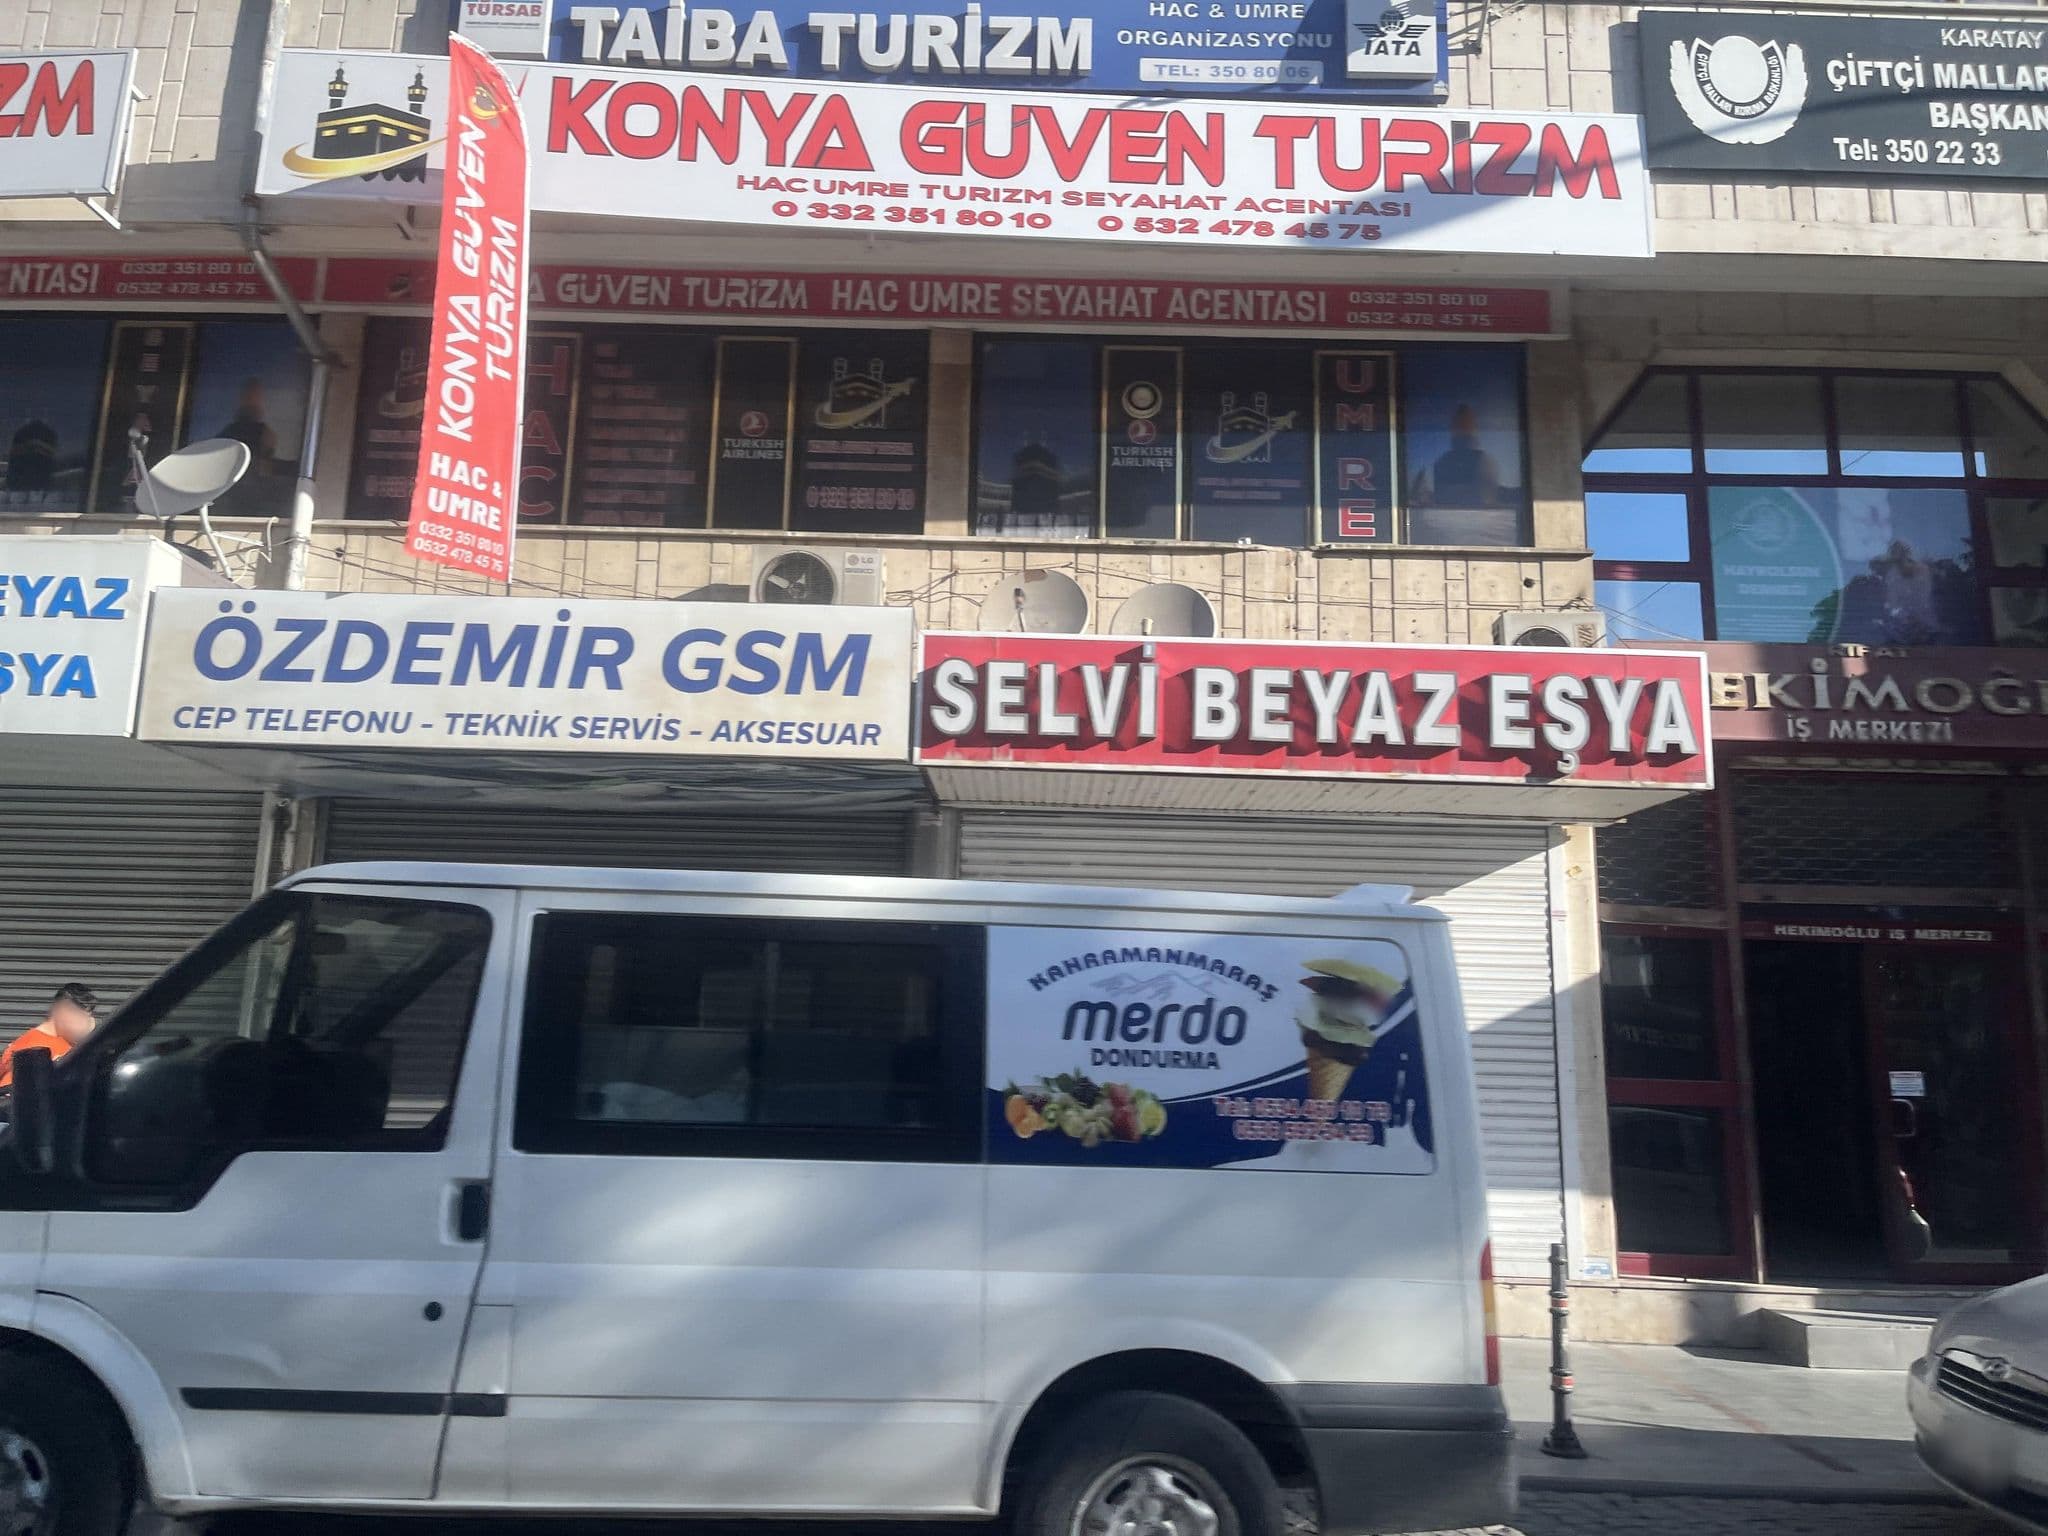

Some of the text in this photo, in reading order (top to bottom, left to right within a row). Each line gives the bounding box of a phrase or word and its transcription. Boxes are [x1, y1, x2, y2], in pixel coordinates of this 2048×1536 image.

[467, 0, 542, 17] TÜRSAB
[1149, 2, 1305, 20] HAC & UMRE
[570, 0, 1093, 74] TAİBA TURİZM
[1117, 28, 1332, 48] ORGANİZASYONU
[1364, 40, 1422, 57] IATA
[1941, 28, 2045, 49] KARATAY
[1154, 64, 1310, 80] TEL: 350 80 06
[1826, 53, 1925, 93] ÇİFTÇİ
[546, 76, 875, 172] KONYA
[1832, 137, 2001, 166] Tel: 350 22 33
[737, 174, 1411, 217] HAC UMRE TURIZM SEYAHAT ACENTASI
[772, 200, 1382, 240] 0 332 351 80 10 0 532 478 45 75
[437, 114, 488, 442] KONYA GÜVEN
[486, 216, 518, 381] TURİZM
[556, 272, 671, 306] GÜVEN
[683, 276, 808, 310] TURİZM
[831, 279, 901, 312] HAC
[909, 280, 1002, 314] UMRE
[1012, 283, 1158, 318] SEYAHAT
[1166, 287, 1326, 323] ACENTASI
[1346, 311, 1394, 325] 0532
[721, 449, 784, 459] AIRLINES
[722, 438, 785, 449] TURKISH
[1111, 446, 1173, 456] TURKISH
[1335, 359, 1376, 537] UMRE
[429, 451, 488, 491] HAC
[491, 481, 503, 500] &
[1111, 457, 1174, 467] AIRLINES
[427, 486, 502, 532] UMRE
[419, 521, 454, 541] 0332
[413, 537, 449, 557] 0532
[193, 599, 873, 696] ÖZDEMİR GSM
[930, 643, 1699, 775] SELVİ BEYAZ EŞYA
[173, 705, 237, 730] CEP
[244, 708, 412, 734] TELEFONU
[444, 710, 562, 738] TEKNİK
[569, 713, 681, 742] SERVİS
[710, 720, 882, 746] AKSESUAR
[1828, 716, 1954, 743] MERKEZİ
[1062, 997, 1247, 1046] merdo
[1091, 1047, 1221, 1070] DONDURMA
